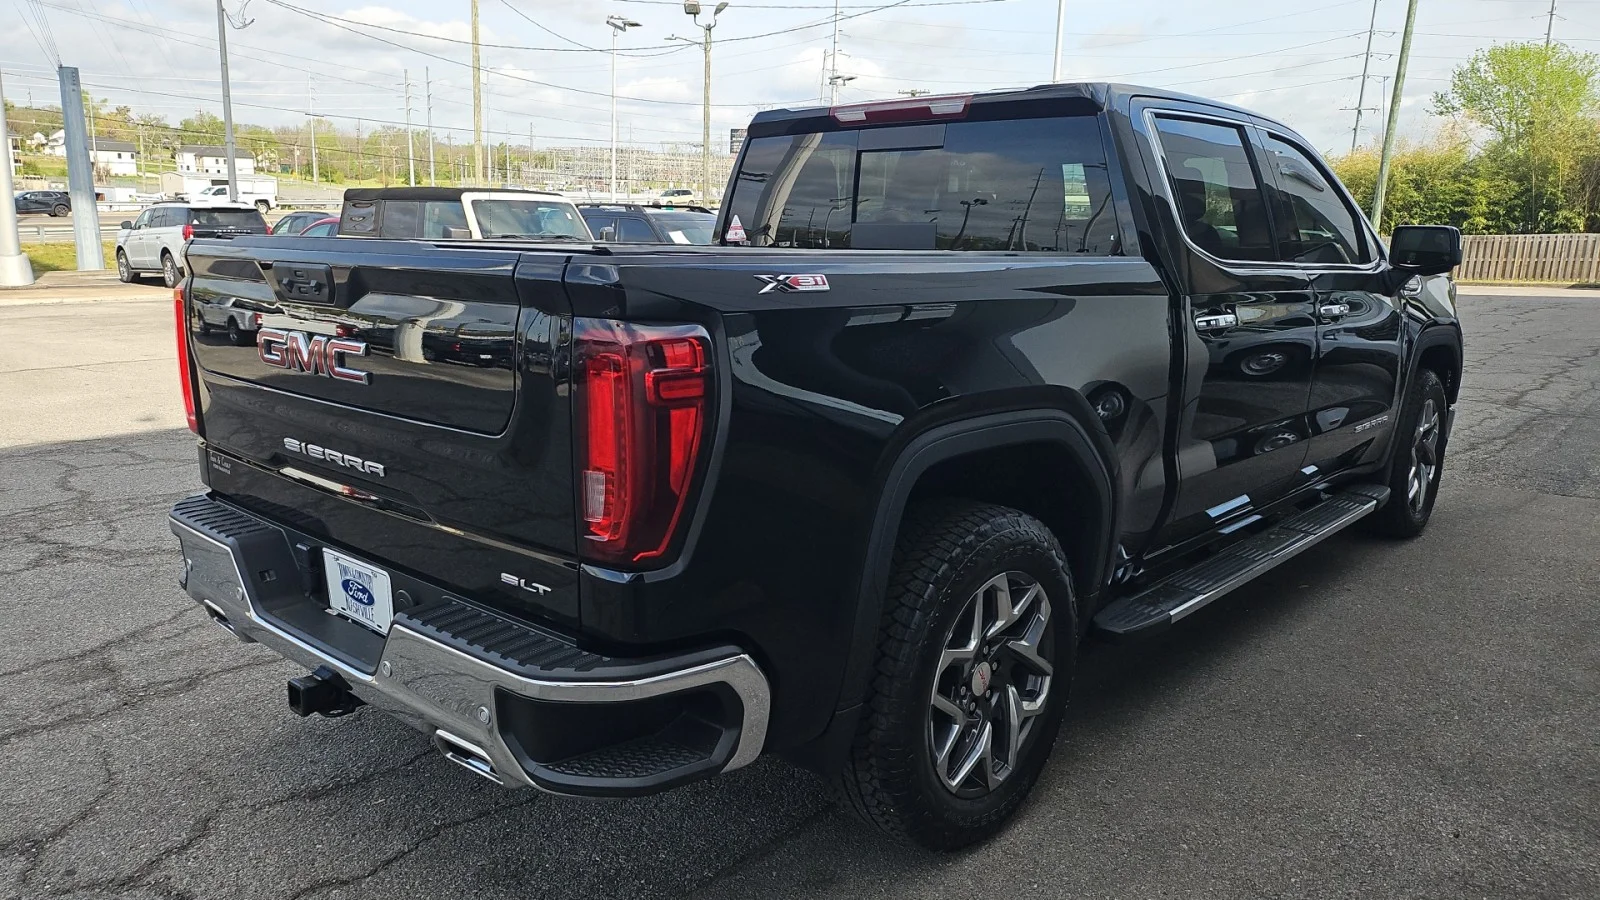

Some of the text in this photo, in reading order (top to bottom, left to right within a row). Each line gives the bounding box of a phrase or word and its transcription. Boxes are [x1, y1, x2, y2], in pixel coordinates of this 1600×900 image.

[753, 274, 830, 294] X31
[256, 327, 371, 386] GMC
[1355, 415, 1388, 432] SIERRA
[283, 437, 386, 478] SIERRA
[347, 580, 369, 604] Ford
[501, 572, 552, 596] SLT
